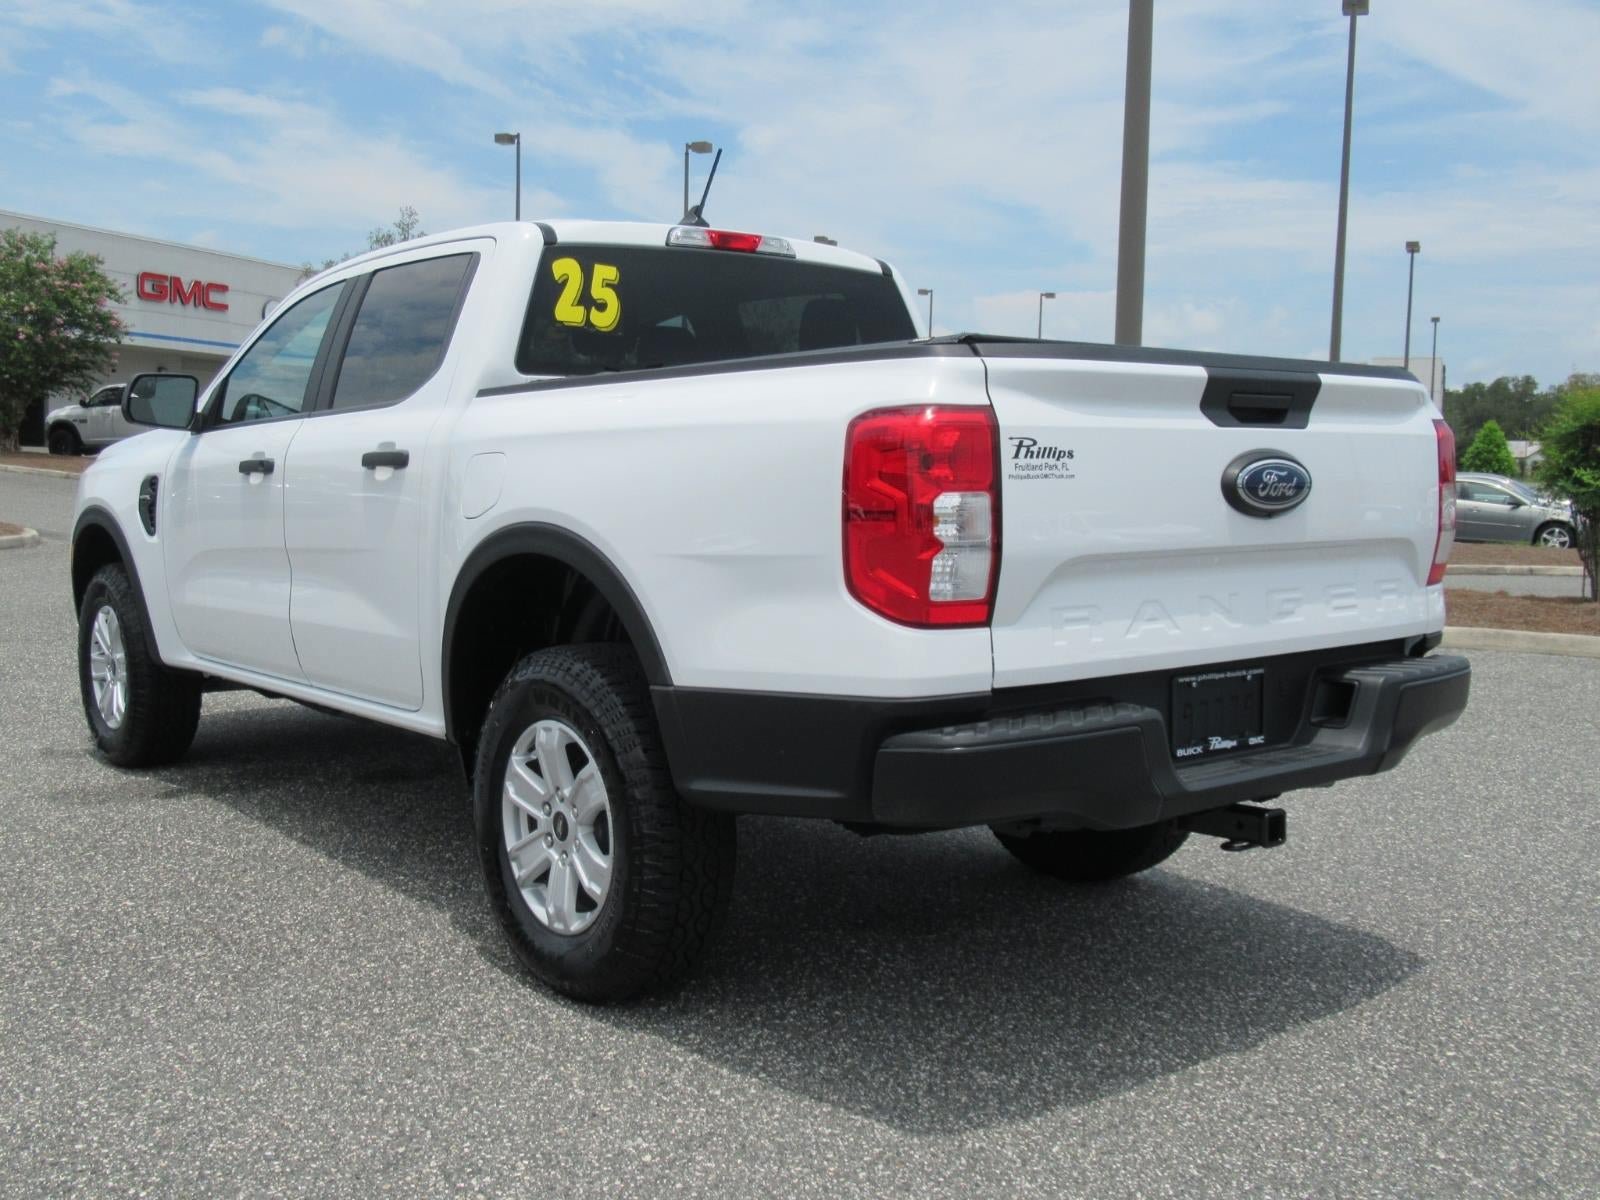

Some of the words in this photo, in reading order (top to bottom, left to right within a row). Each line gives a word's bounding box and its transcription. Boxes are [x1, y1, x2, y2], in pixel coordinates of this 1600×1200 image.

[137, 271, 230, 312] GMC
[551, 257, 621, 332] 25
[1008, 436, 1075, 462] Phillips
[1014, 462, 1043, 472] Fruitland
[1061, 462, 1070, 471] FL
[1257, 469, 1297, 497] Ford
[1050, 577, 1405, 646] RANGER
[1176, 745, 1203, 757] BUICK
